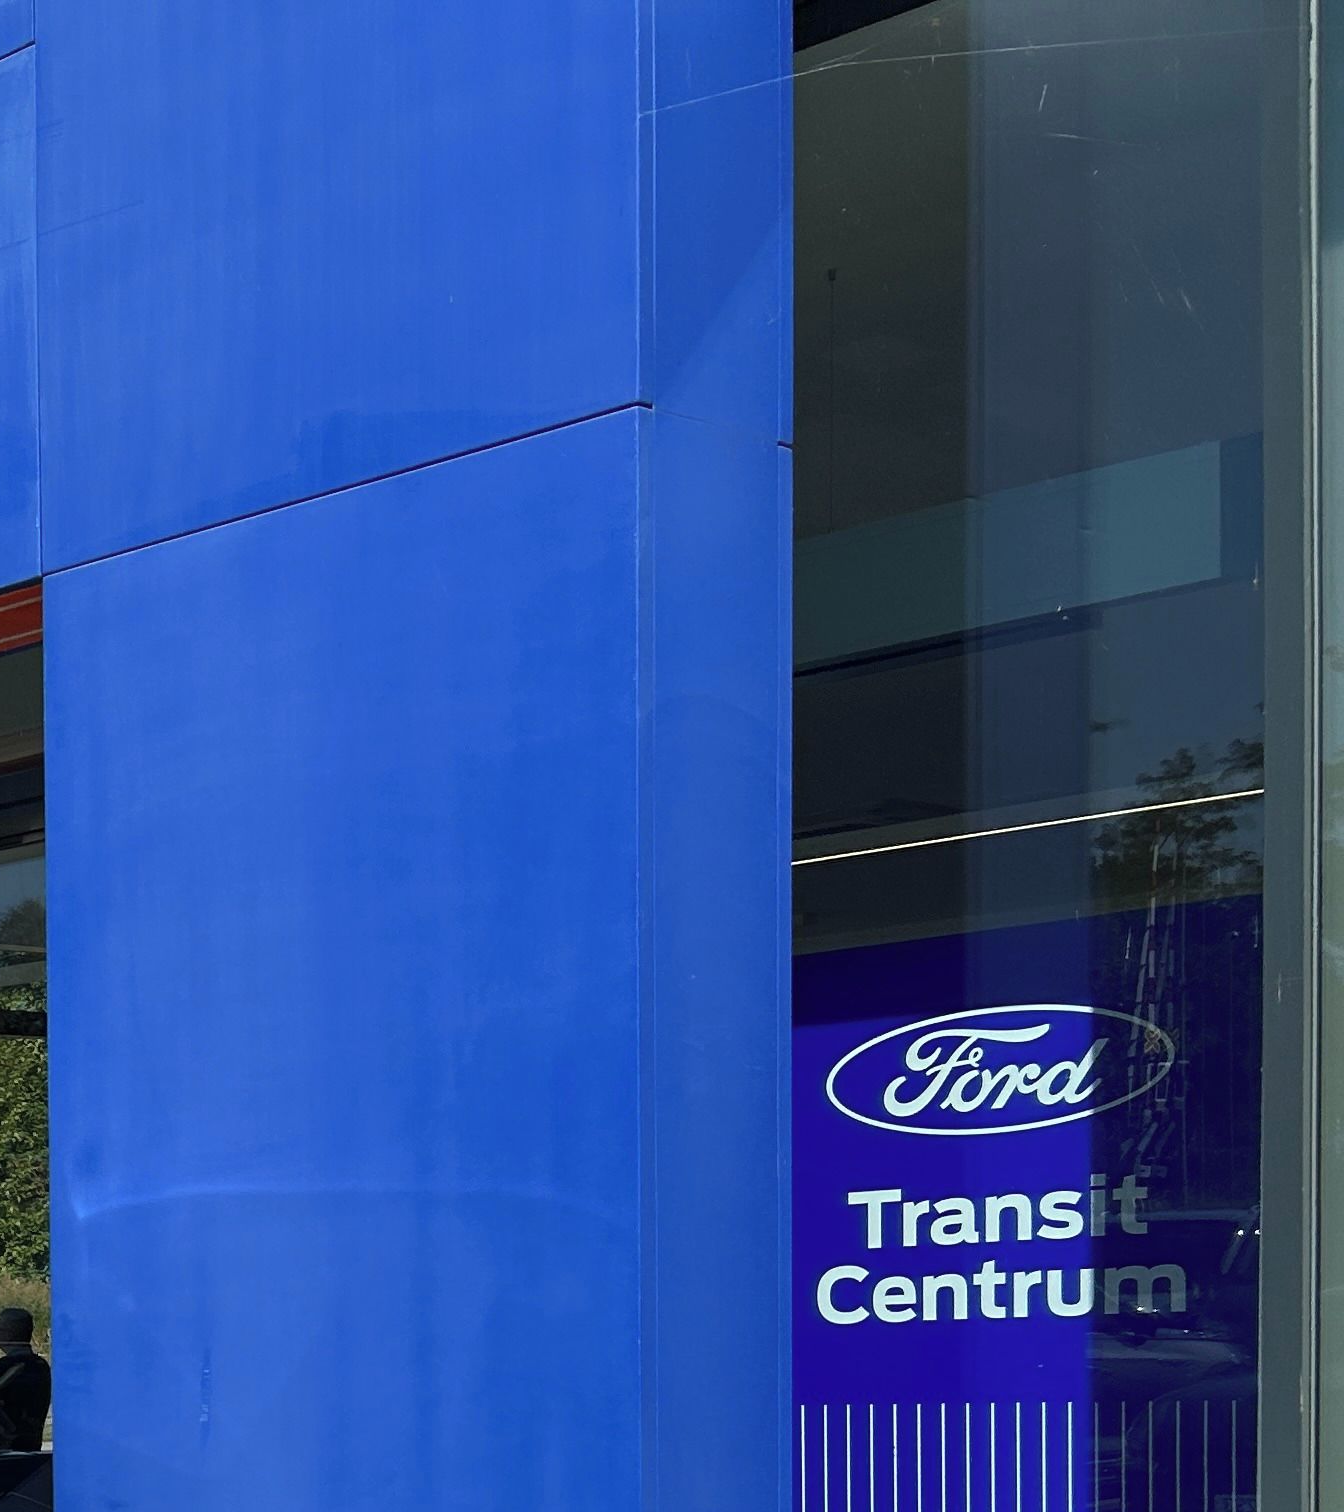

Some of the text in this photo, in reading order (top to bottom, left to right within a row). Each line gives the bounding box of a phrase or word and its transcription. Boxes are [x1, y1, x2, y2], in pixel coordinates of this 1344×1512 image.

[883, 1022, 1109, 1118] Ford
[847, 1173, 1149, 1249] Transit
[815, 1259, 1187, 1325] Centrum
